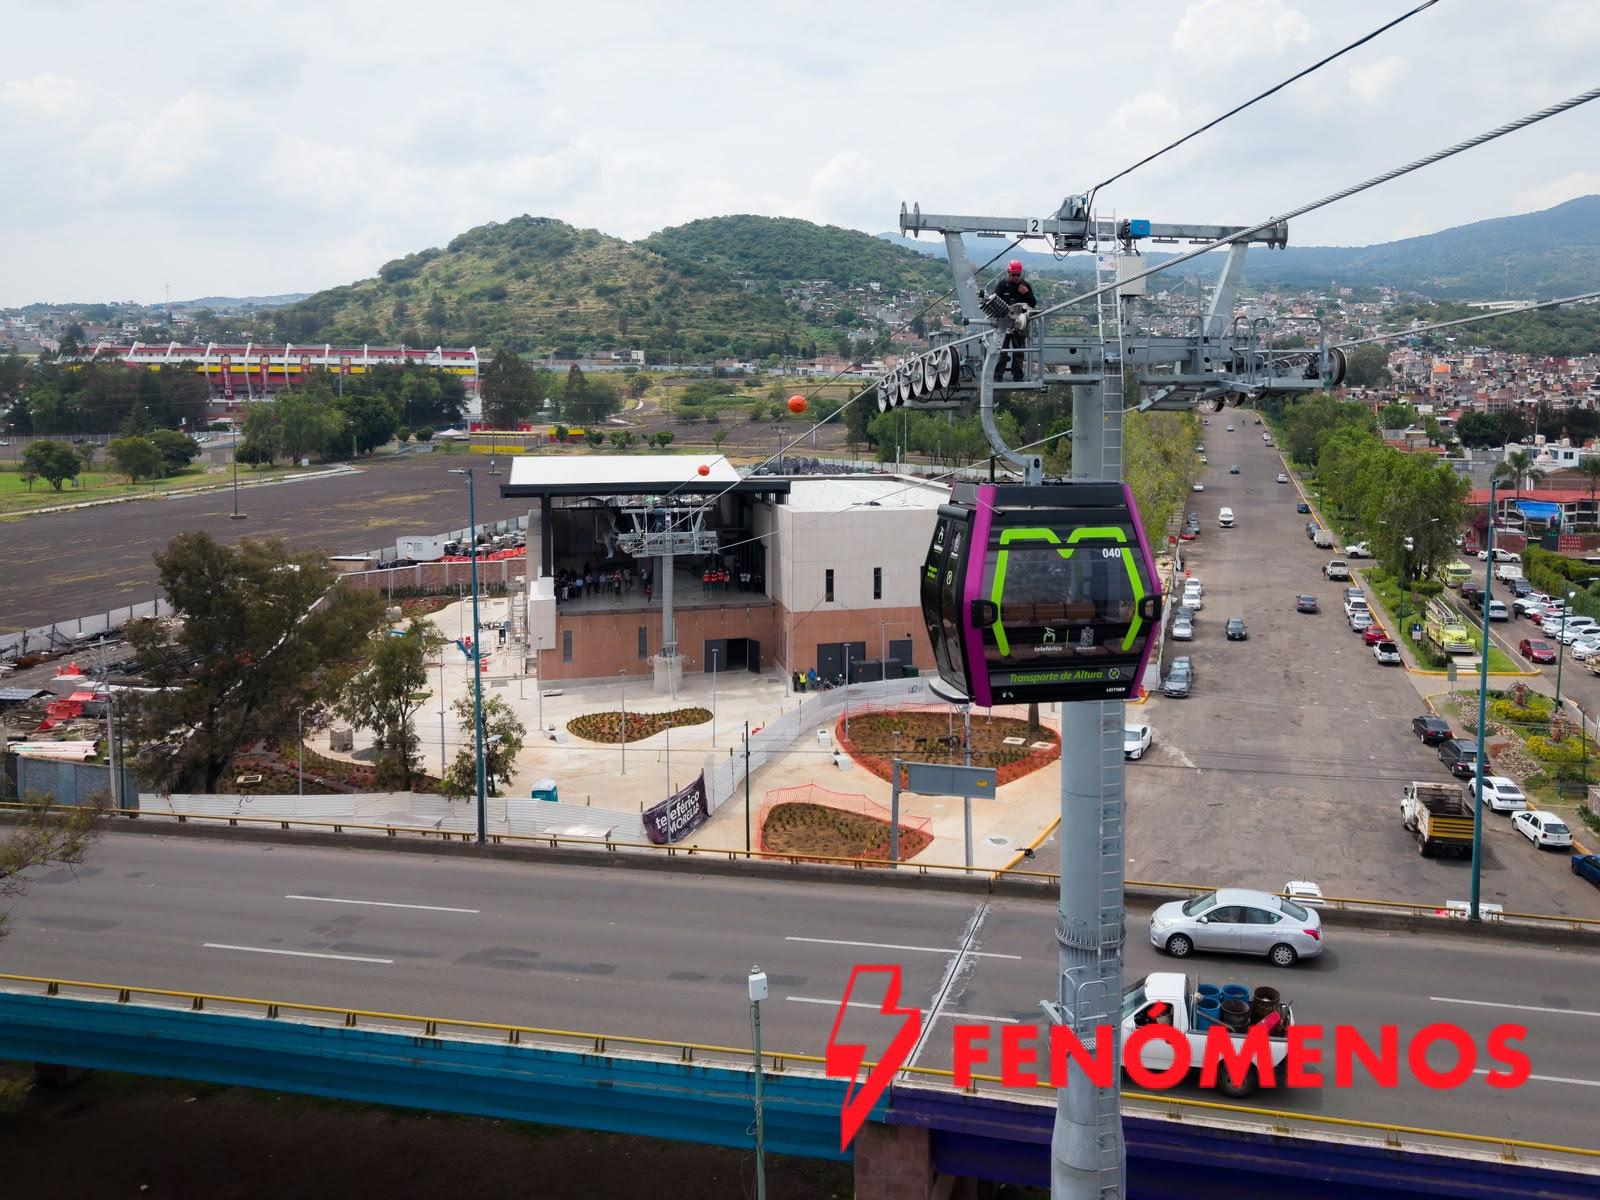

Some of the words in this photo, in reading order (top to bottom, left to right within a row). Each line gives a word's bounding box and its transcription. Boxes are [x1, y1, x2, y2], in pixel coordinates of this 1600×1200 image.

[1031, 219, 1039, 232] 2
[1102, 548, 1121, 558] 040
[1009, 672, 1059, 684] Transporte
[1060, 671, 1072, 681] de
[1073, 670, 1104, 680] Altura
[668, 802, 700, 834] MORELIA
